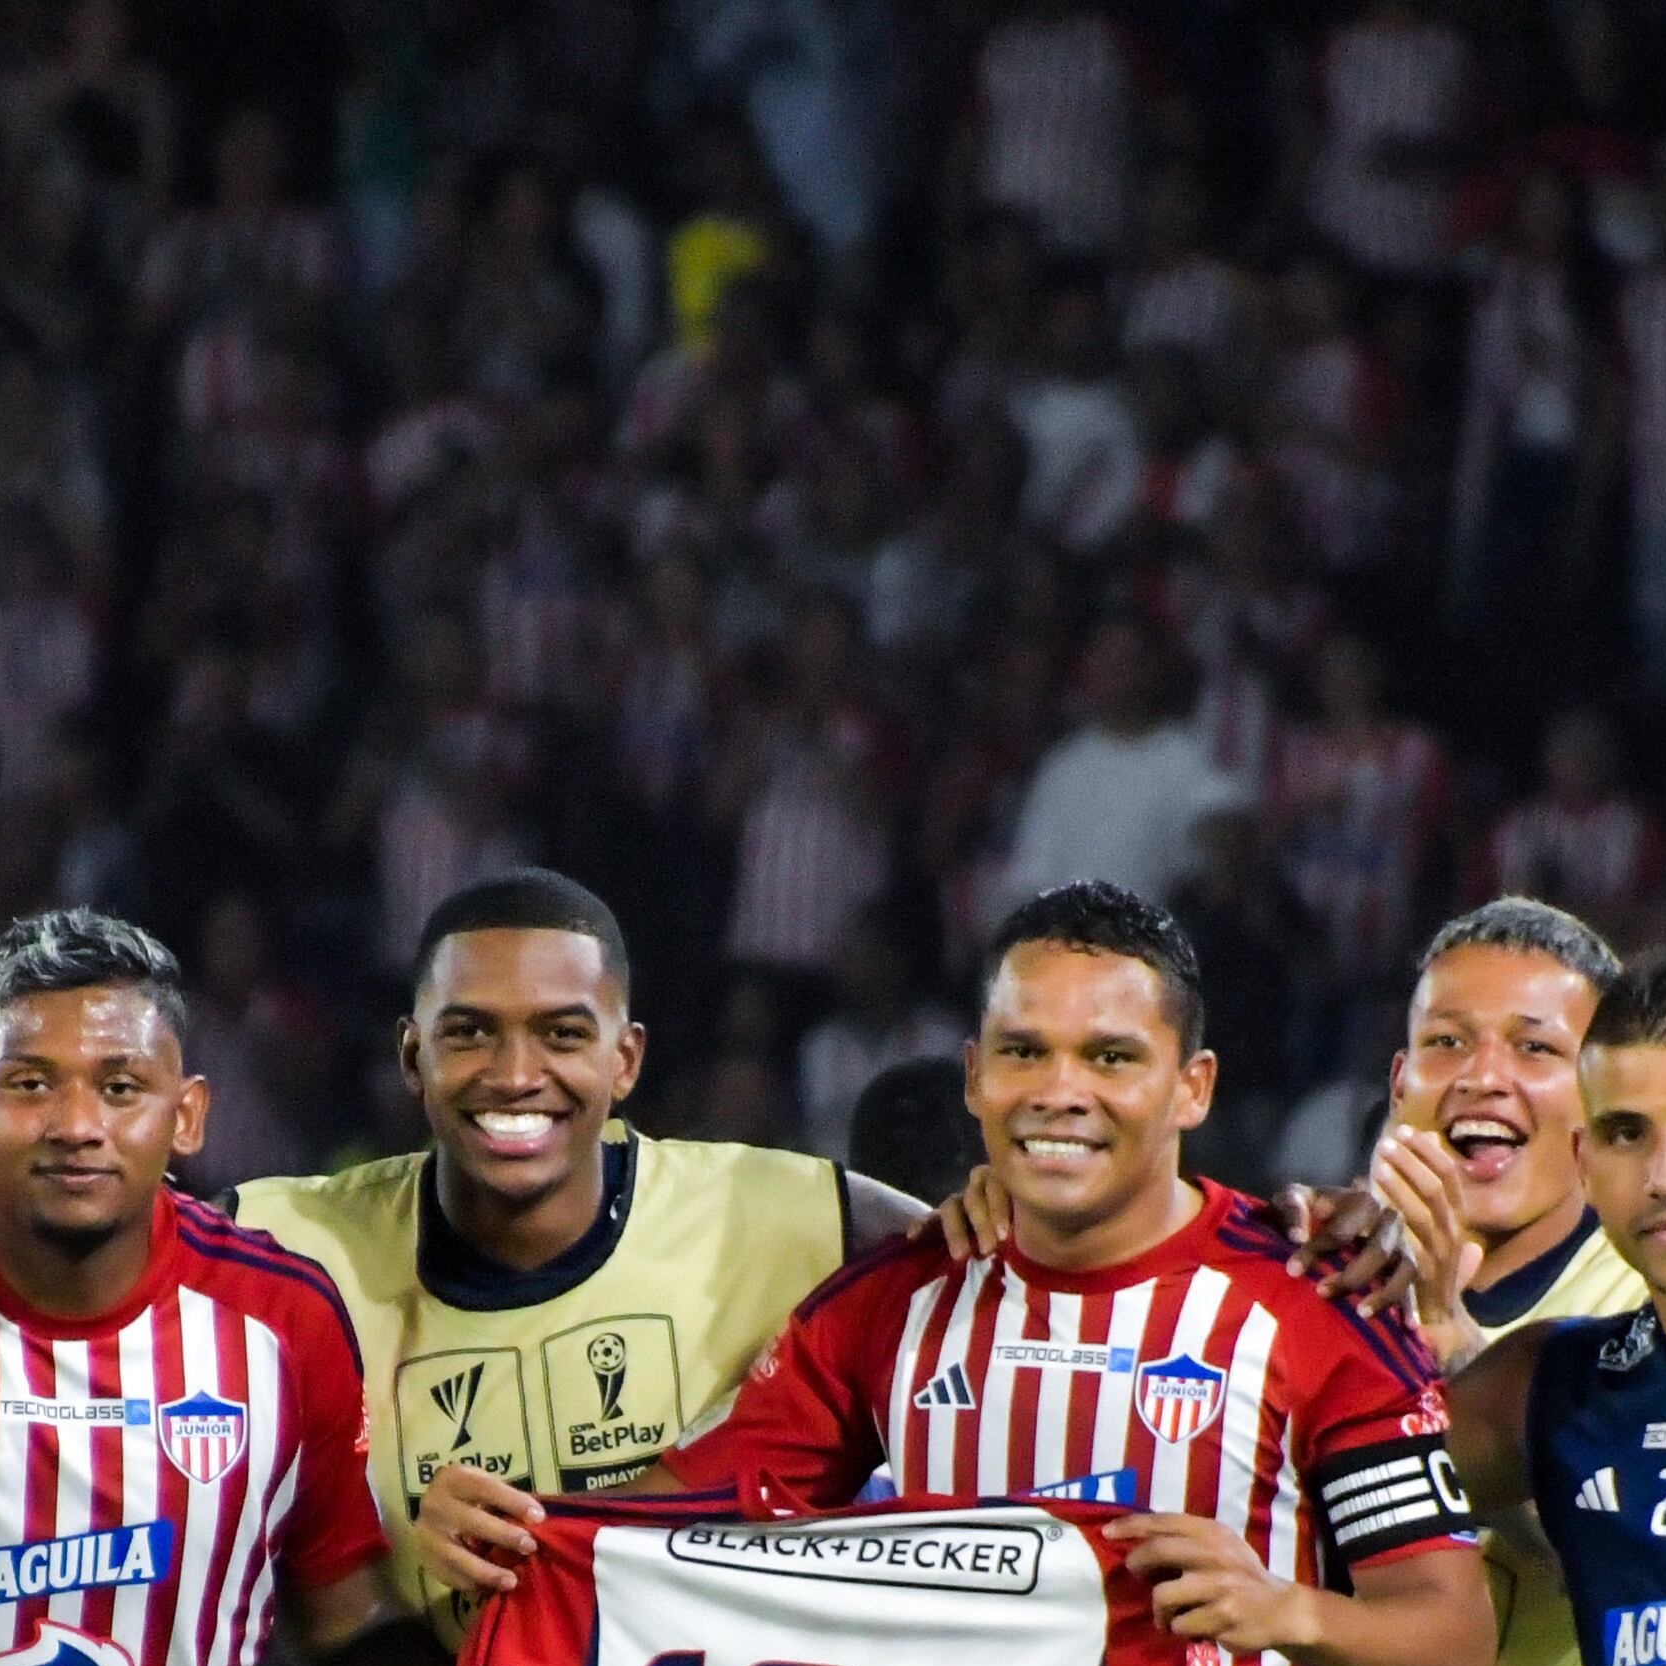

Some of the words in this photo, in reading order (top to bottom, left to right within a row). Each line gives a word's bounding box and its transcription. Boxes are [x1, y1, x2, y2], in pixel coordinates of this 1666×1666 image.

[1151, 1384, 1208, 1398] JUNIOR
[175, 1423, 232, 1436] JUNIOR
[569, 1422, 665, 1456] BetPlay
[687, 1528, 1023, 1576] BLACK+DECKER
